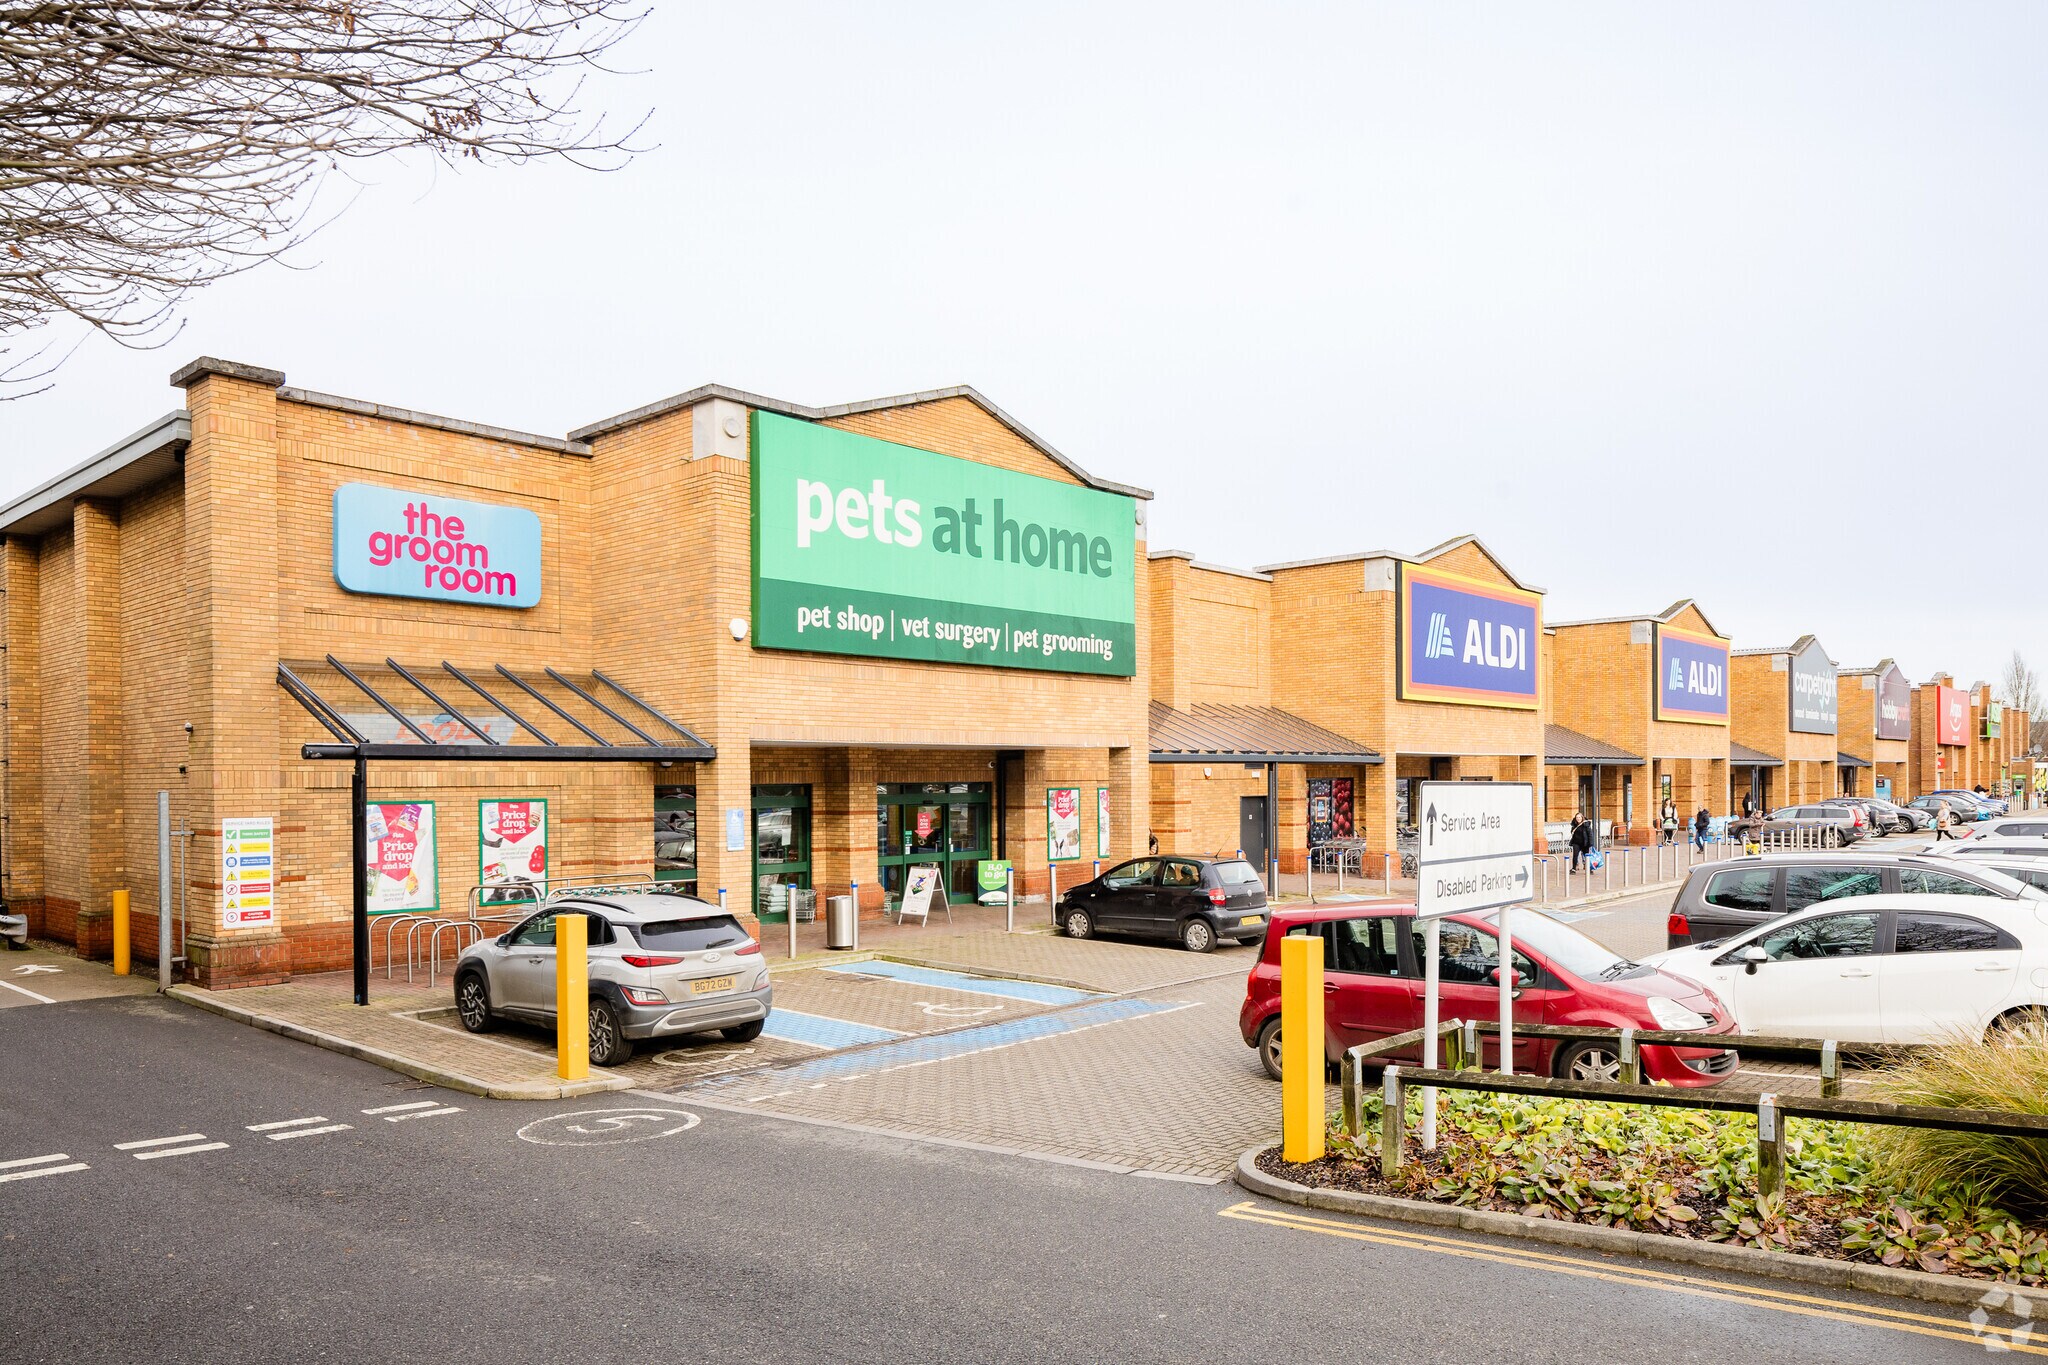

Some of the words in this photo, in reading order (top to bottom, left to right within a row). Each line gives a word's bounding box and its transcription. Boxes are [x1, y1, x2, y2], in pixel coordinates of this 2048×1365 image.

[403, 502, 465, 541] the
[797, 478, 922, 548] pets
[932, 498, 982, 558] at
[994, 499, 1112, 578] home
[369, 531, 488, 568] groom
[425, 564, 516, 597] room
[797, 605, 831, 633] pet
[837, 607, 884, 639] shop
[902, 616, 930, 639] vet
[935, 621, 1000, 651] surgery
[1013, 627, 1039, 653] pet
[1042, 632, 1113, 661] grooming
[1463, 619, 1525, 671] ALDI
[1688, 660, 1722, 697] ALDI
[1795, 669, 1837, 708] carpetright
[502, 811, 526, 819] Price
[502, 819, 526, 829] drop
[1441, 813, 1476, 832] Service
[1480, 812, 1500, 830] Area
[383, 841, 414, 851] Price
[383, 851, 413, 862] drop
[382, 862, 397, 870] and
[1437, 875, 1477, 898] Disabled
[1481, 872, 1512, 891] Parking
[695, 980, 716, 991] BG72
